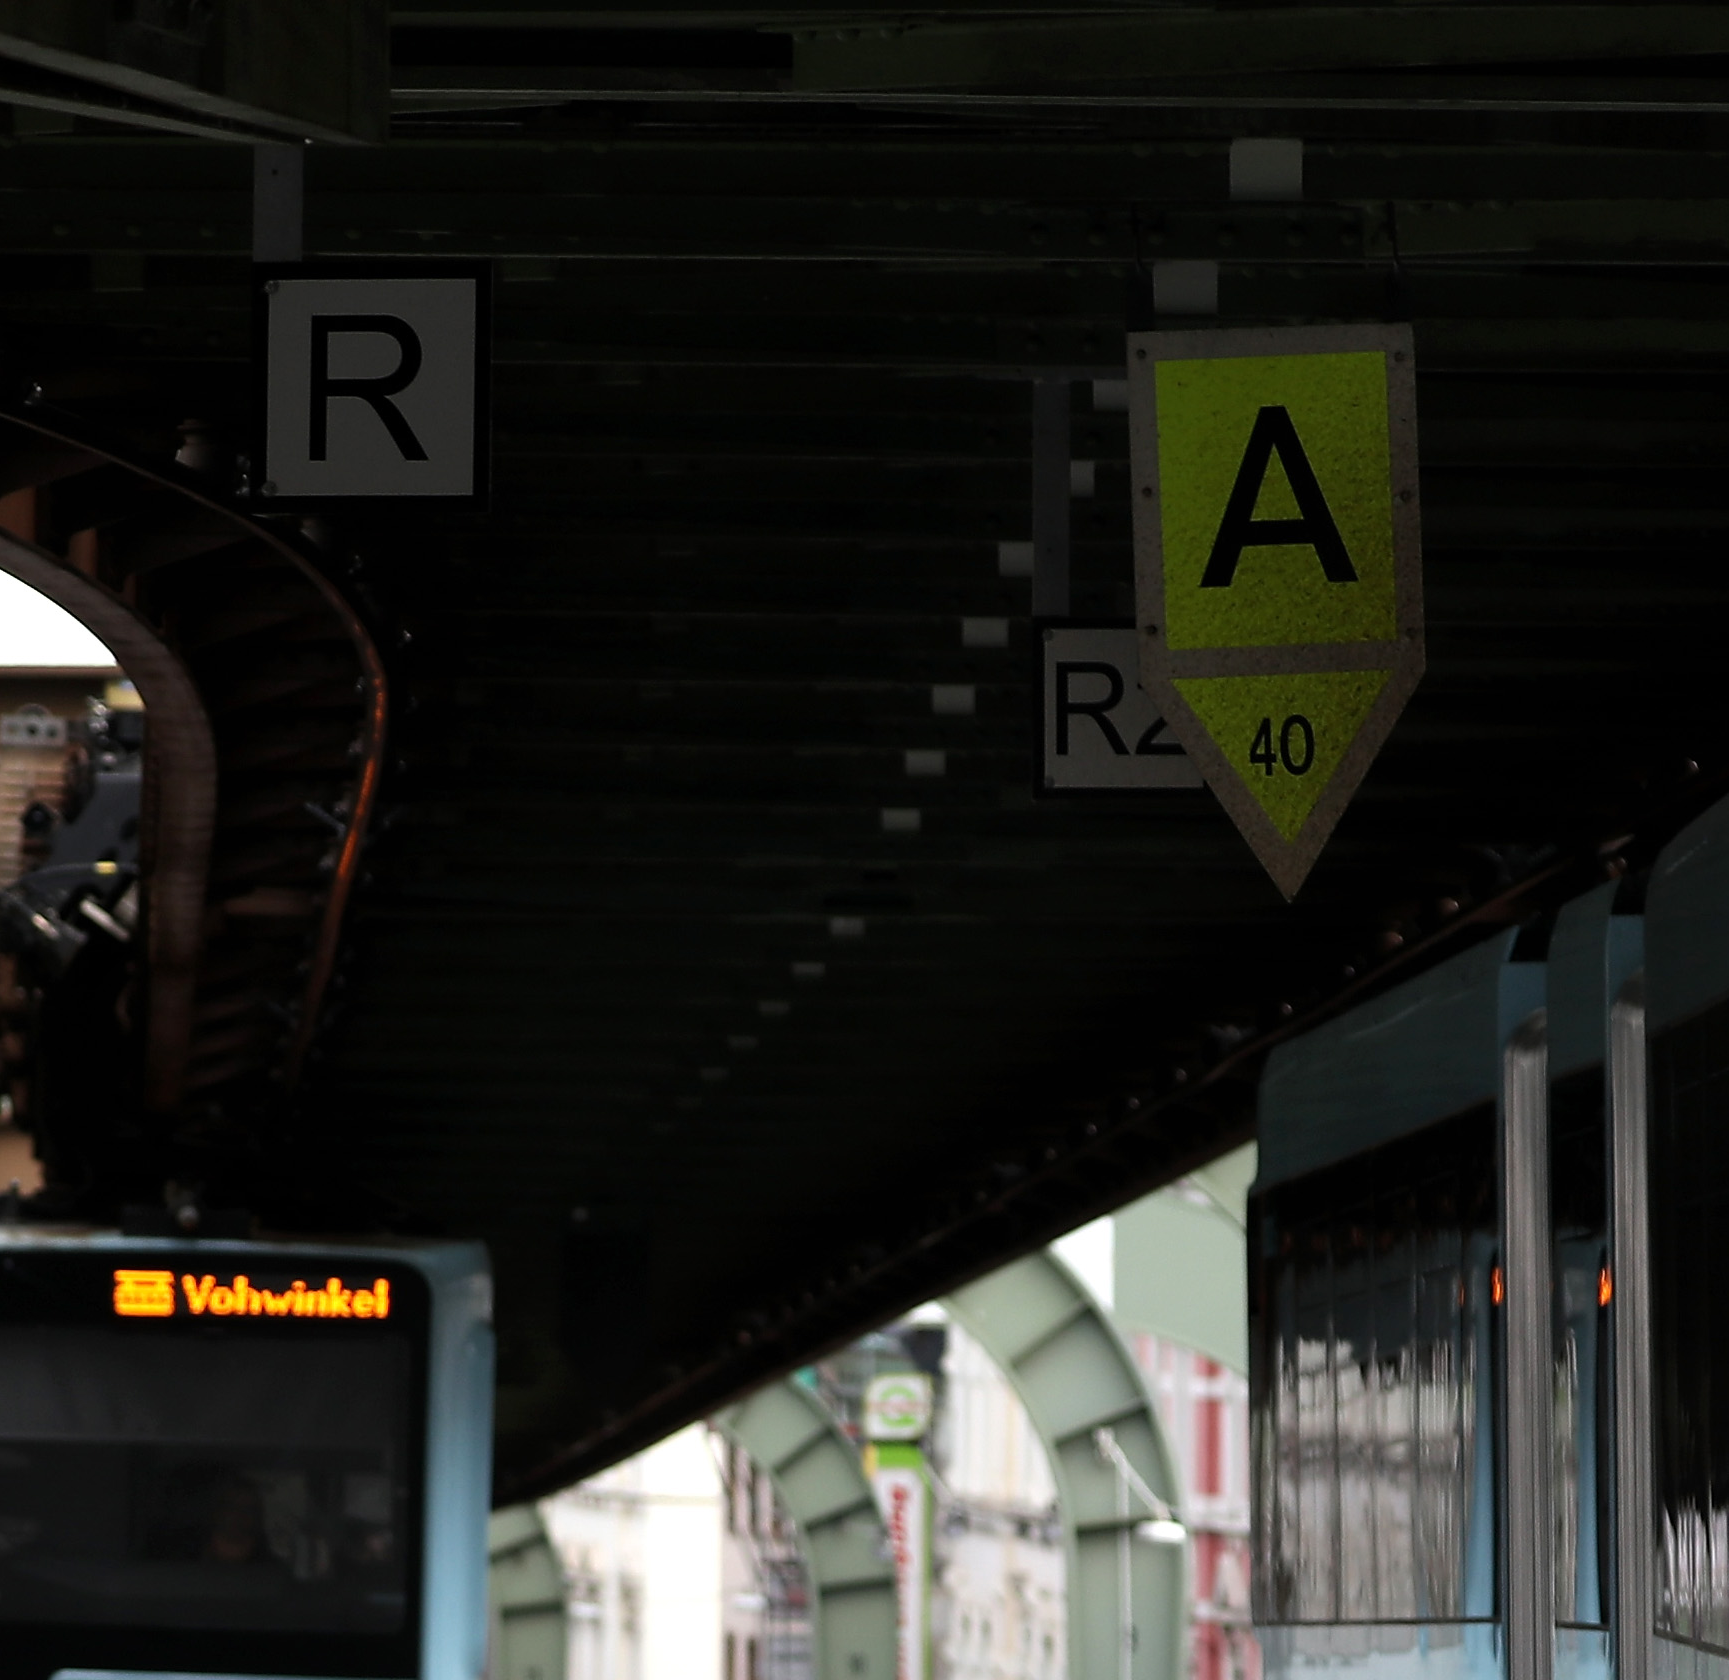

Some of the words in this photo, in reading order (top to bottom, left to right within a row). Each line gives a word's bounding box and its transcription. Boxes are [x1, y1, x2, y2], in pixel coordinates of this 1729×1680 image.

[308, 313, 429, 461] R
[1199, 404, 1359, 588] A
[1248, 714, 1315, 777] 40
[180, 1274, 391, 1319] Vohwinkel
